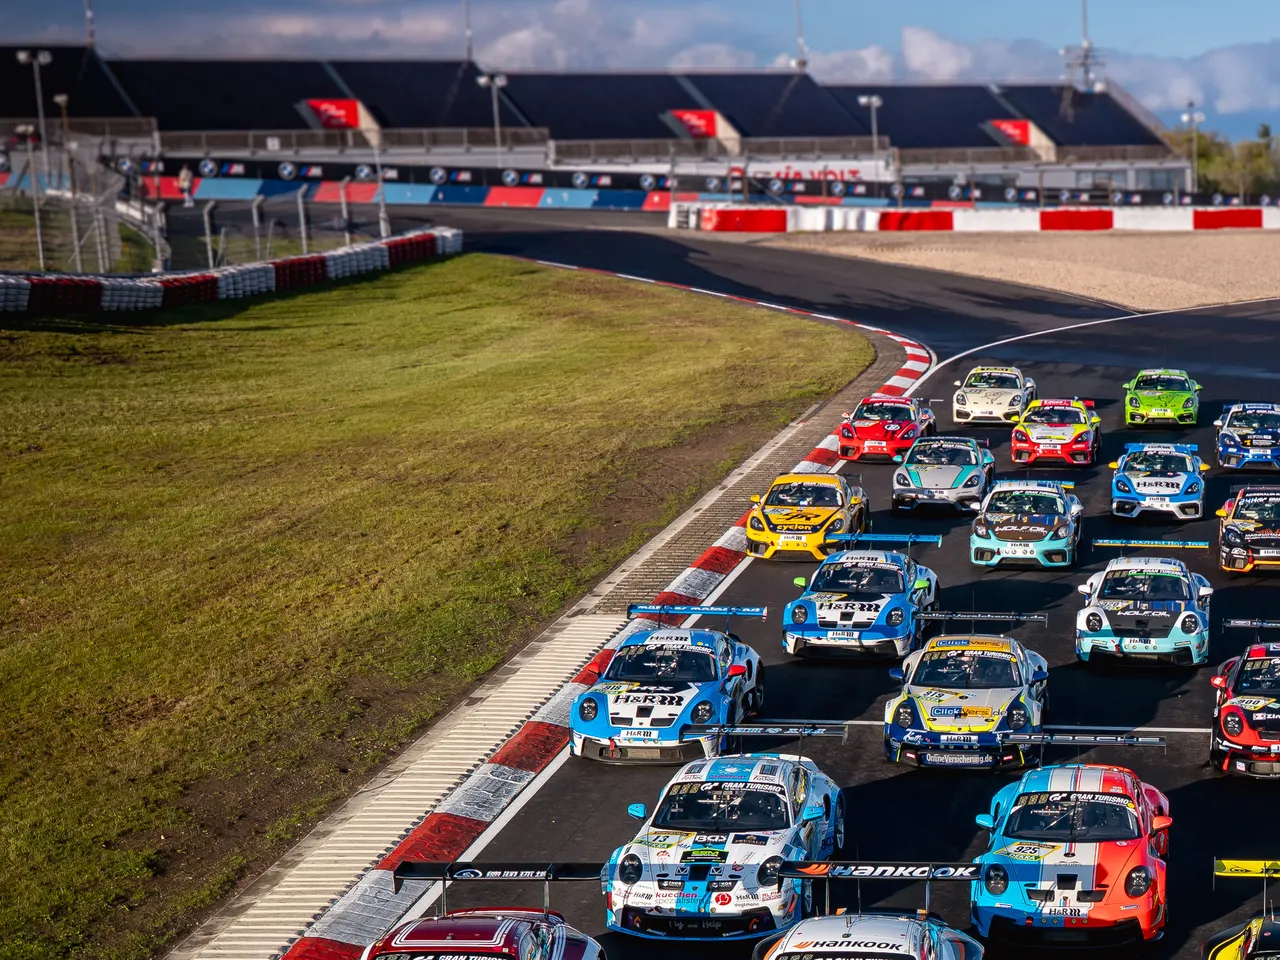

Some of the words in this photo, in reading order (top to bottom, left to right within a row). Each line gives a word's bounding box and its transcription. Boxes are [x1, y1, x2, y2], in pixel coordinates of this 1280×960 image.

[684, 644, 712, 653] TURISMO
[983, 651, 1012, 659] TURISMO
[925, 753, 993, 765] OnlineVersicherung.de
[722, 782, 744, 790] GRAN
[745, 782, 783, 793] TURISMO
[1070, 793, 1093, 801] GRAN
[1094, 794, 1129, 805] TURISMO
[652, 834, 669, 843] 13
[1013, 845, 1038, 855] 925
